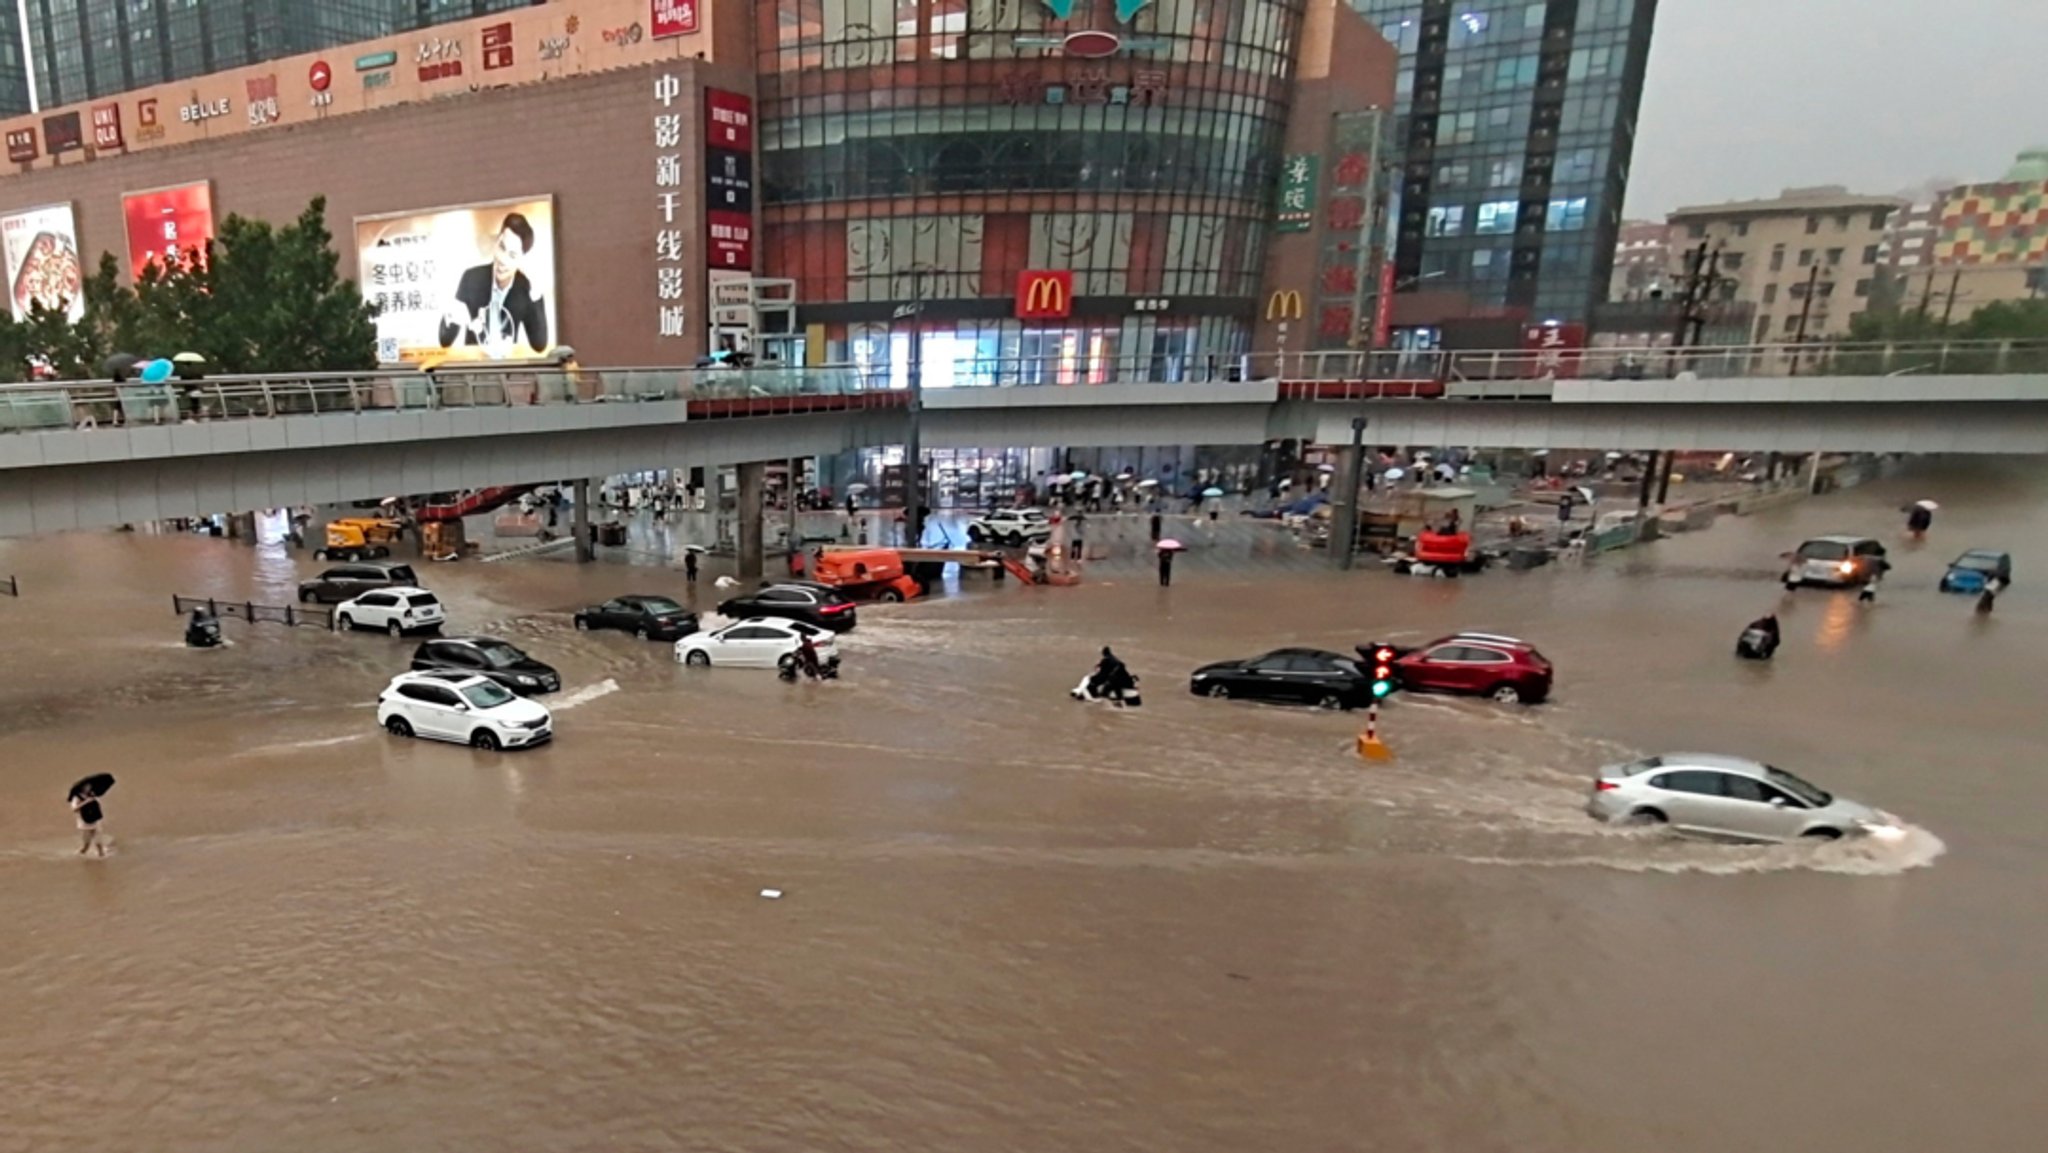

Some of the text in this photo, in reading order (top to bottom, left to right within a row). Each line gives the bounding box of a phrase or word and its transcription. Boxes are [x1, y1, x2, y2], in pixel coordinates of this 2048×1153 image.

[94, 107, 114, 126] UNI
[180, 98, 230, 122] BELLE
[96, 125, 118, 146] QLO
[655, 74, 684, 337] 中影新干线影城
